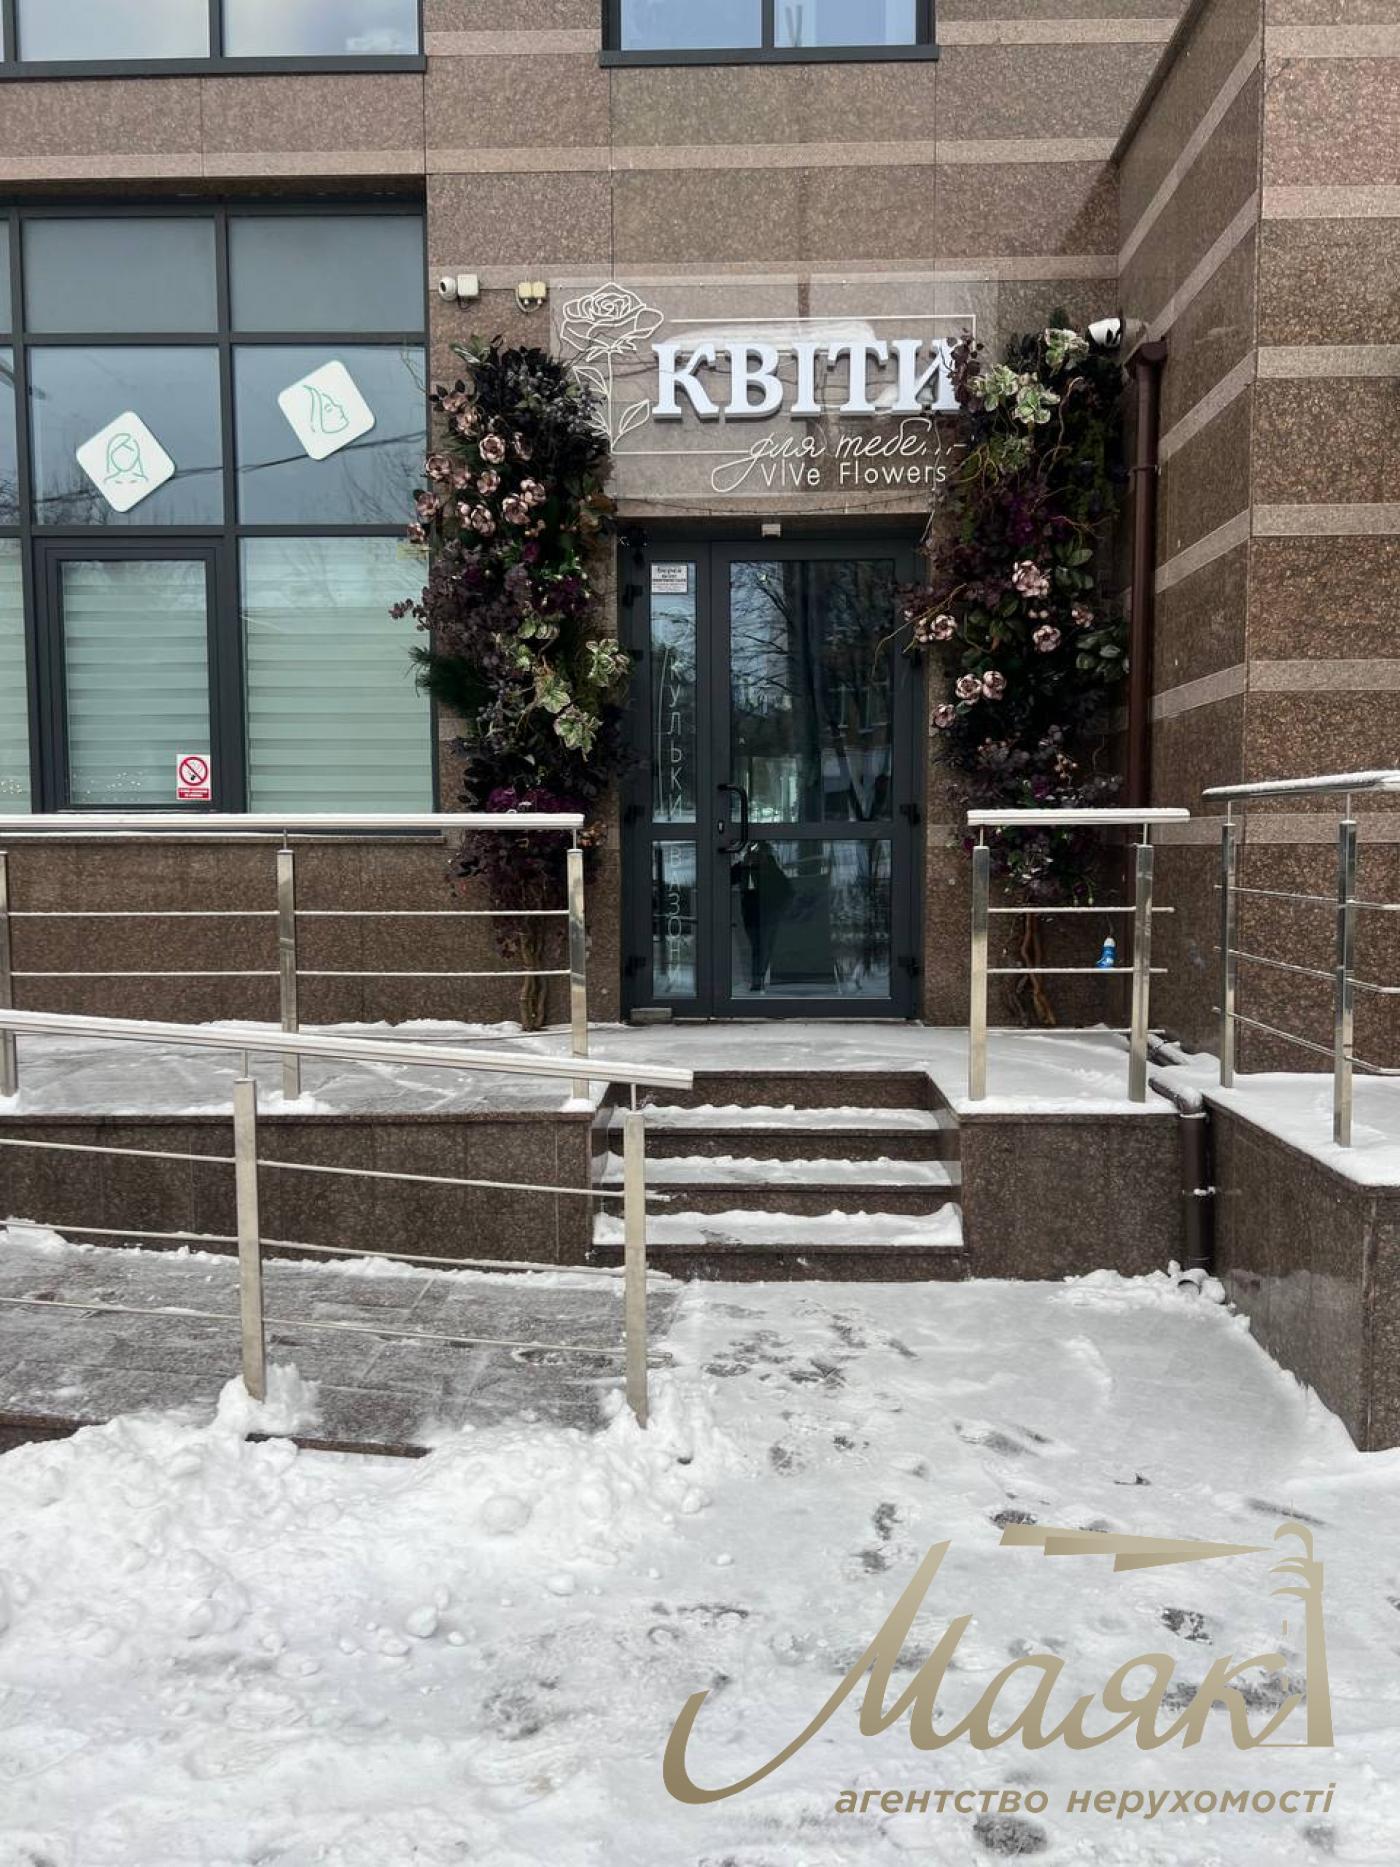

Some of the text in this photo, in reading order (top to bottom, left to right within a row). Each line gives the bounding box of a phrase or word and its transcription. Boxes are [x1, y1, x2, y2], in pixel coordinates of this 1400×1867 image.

[651, 339, 961, 420] КВІТИ
[712, 432, 826, 492] для
[839, 459, 947, 485] Flowers
